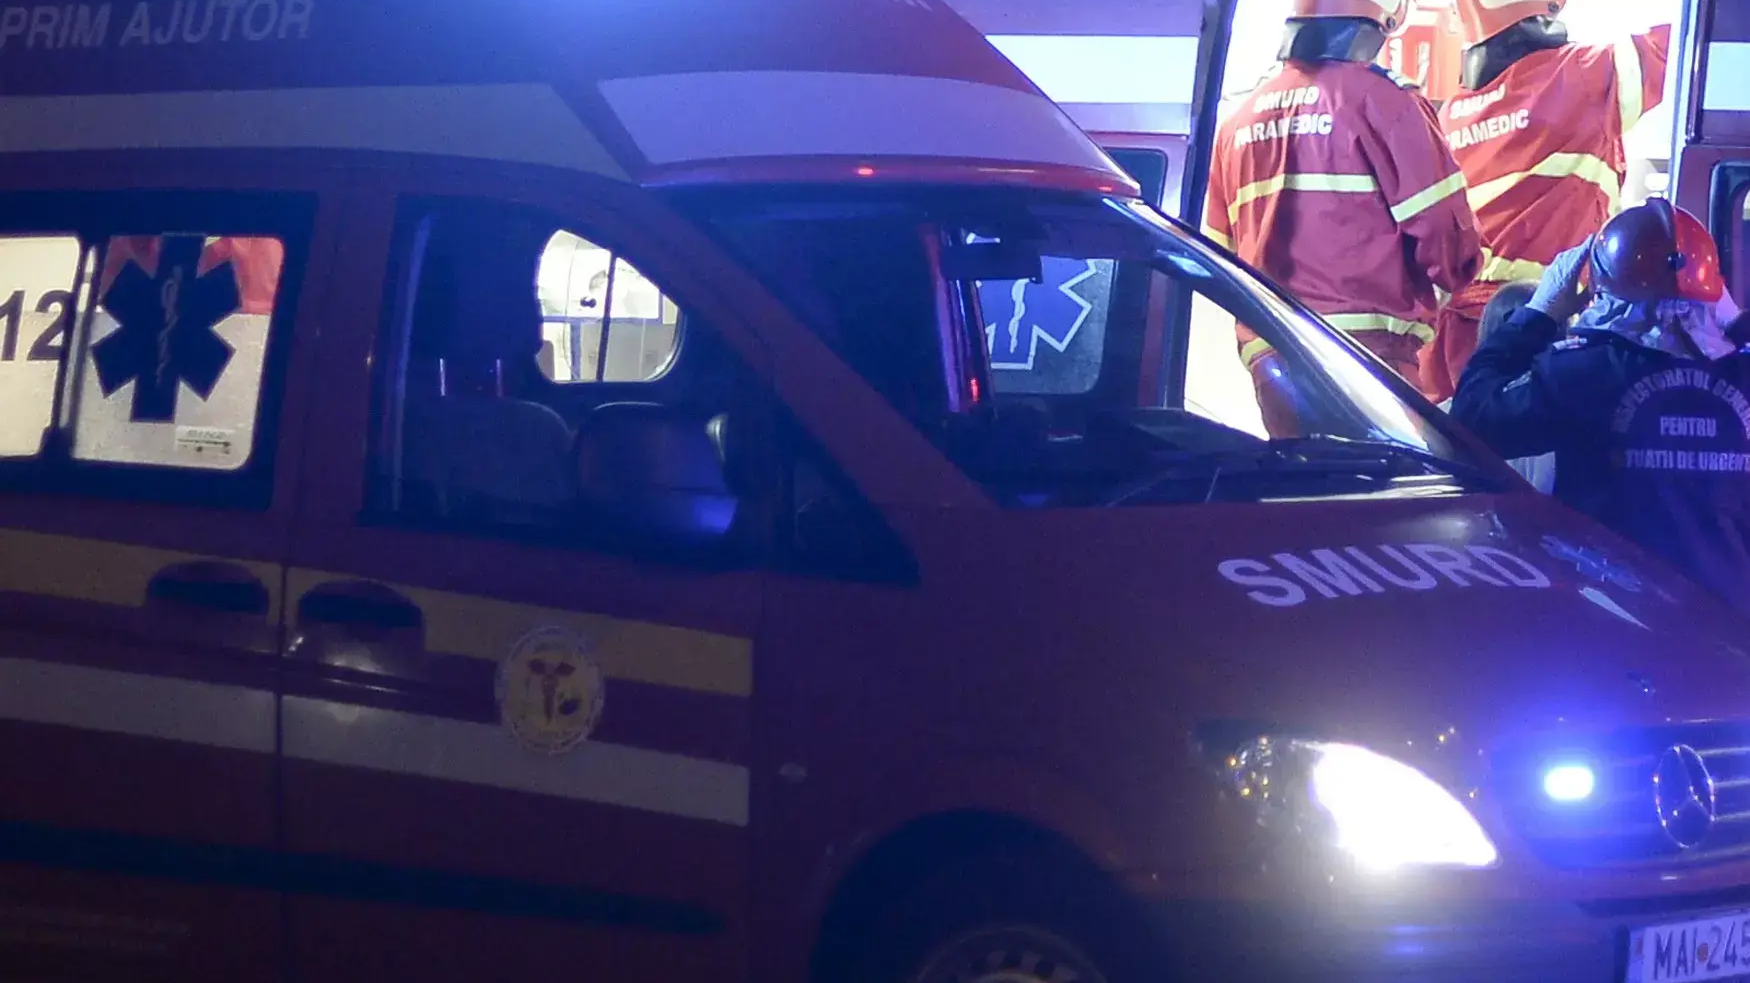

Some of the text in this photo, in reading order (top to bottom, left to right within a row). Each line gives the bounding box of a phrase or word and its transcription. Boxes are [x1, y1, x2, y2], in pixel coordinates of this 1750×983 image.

[0, 2, 111, 49] PRIM
[1445, 109, 1529, 150] RAMEDIC
[1660, 416, 1717, 438] PENTRU
[1677, 450, 1697, 470] DE
[1218, 544, 1551, 607] SMURD
[1654, 928, 1697, 980] MAI
